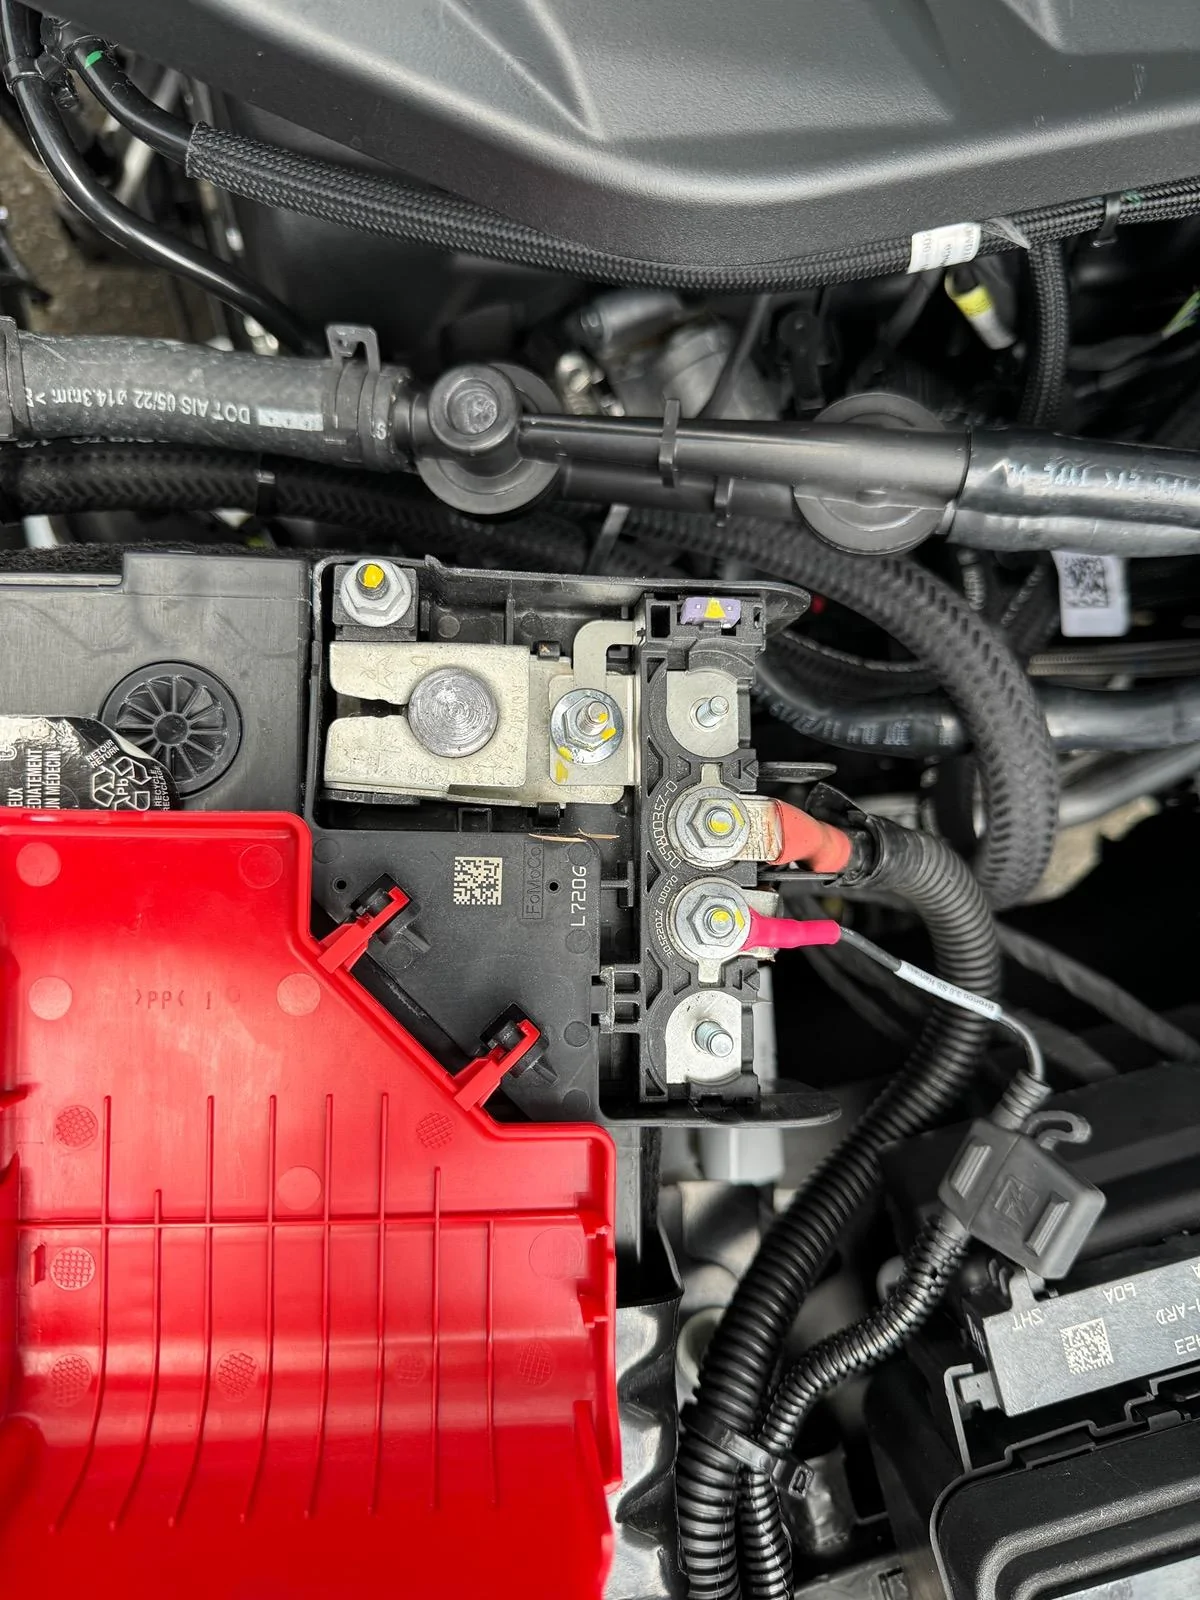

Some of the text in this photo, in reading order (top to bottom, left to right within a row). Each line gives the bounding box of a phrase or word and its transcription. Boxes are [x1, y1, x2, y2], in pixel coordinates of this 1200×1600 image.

[132, 388, 176, 412] 05/22
[182, 395, 209, 417] AIS
[213, 402, 250, 424] DOT
[85, 738, 114, 763] RETOUR
[90, 744, 120, 769] RETURN
[42, 750, 61, 795] MÉDECIN
[116, 778, 129, 796] Pb
[526, 846, 542, 914] FoMoCo
[570, 865, 587, 927] L720G
[1011, 1282, 1137, 1331] 60A SHT
